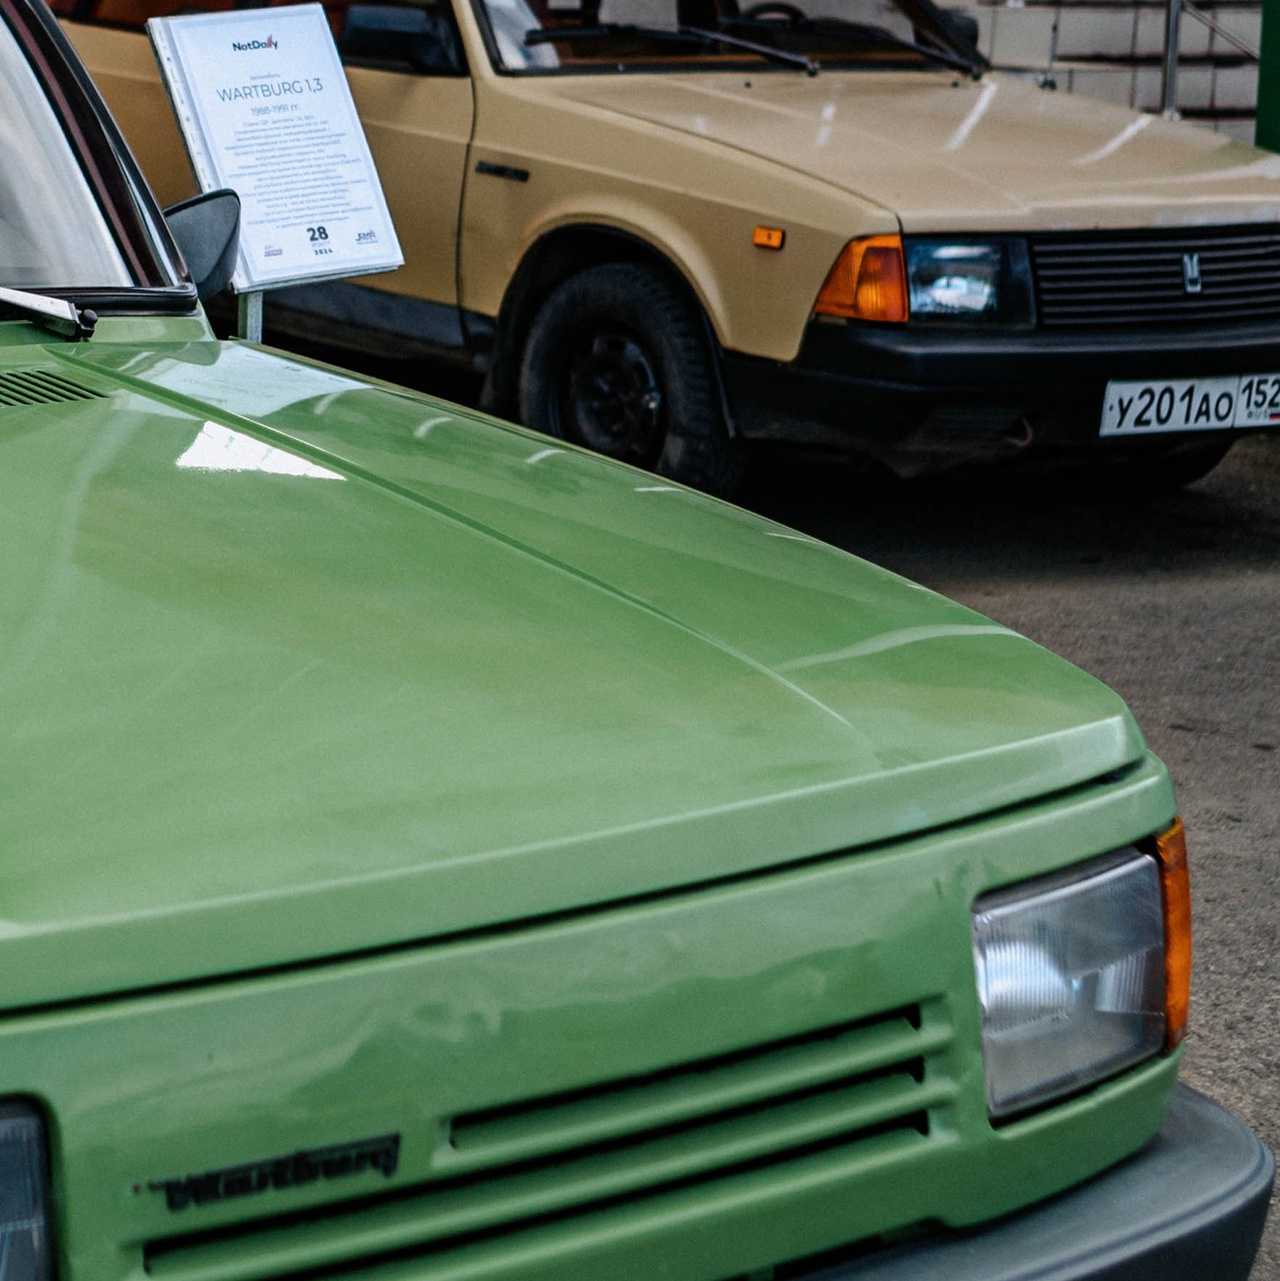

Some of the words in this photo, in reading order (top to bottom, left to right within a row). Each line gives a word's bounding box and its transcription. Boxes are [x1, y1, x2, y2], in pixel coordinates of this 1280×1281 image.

[216, 80, 303, 102] WARTBURG
[305, 77, 324, 94] 1,3
[250, 103, 289, 116] 1988-1991
[306, 226, 329, 242] 28
[1116, 384, 1234, 428] У201АО
[1241, 377, 1280, 410] 152
